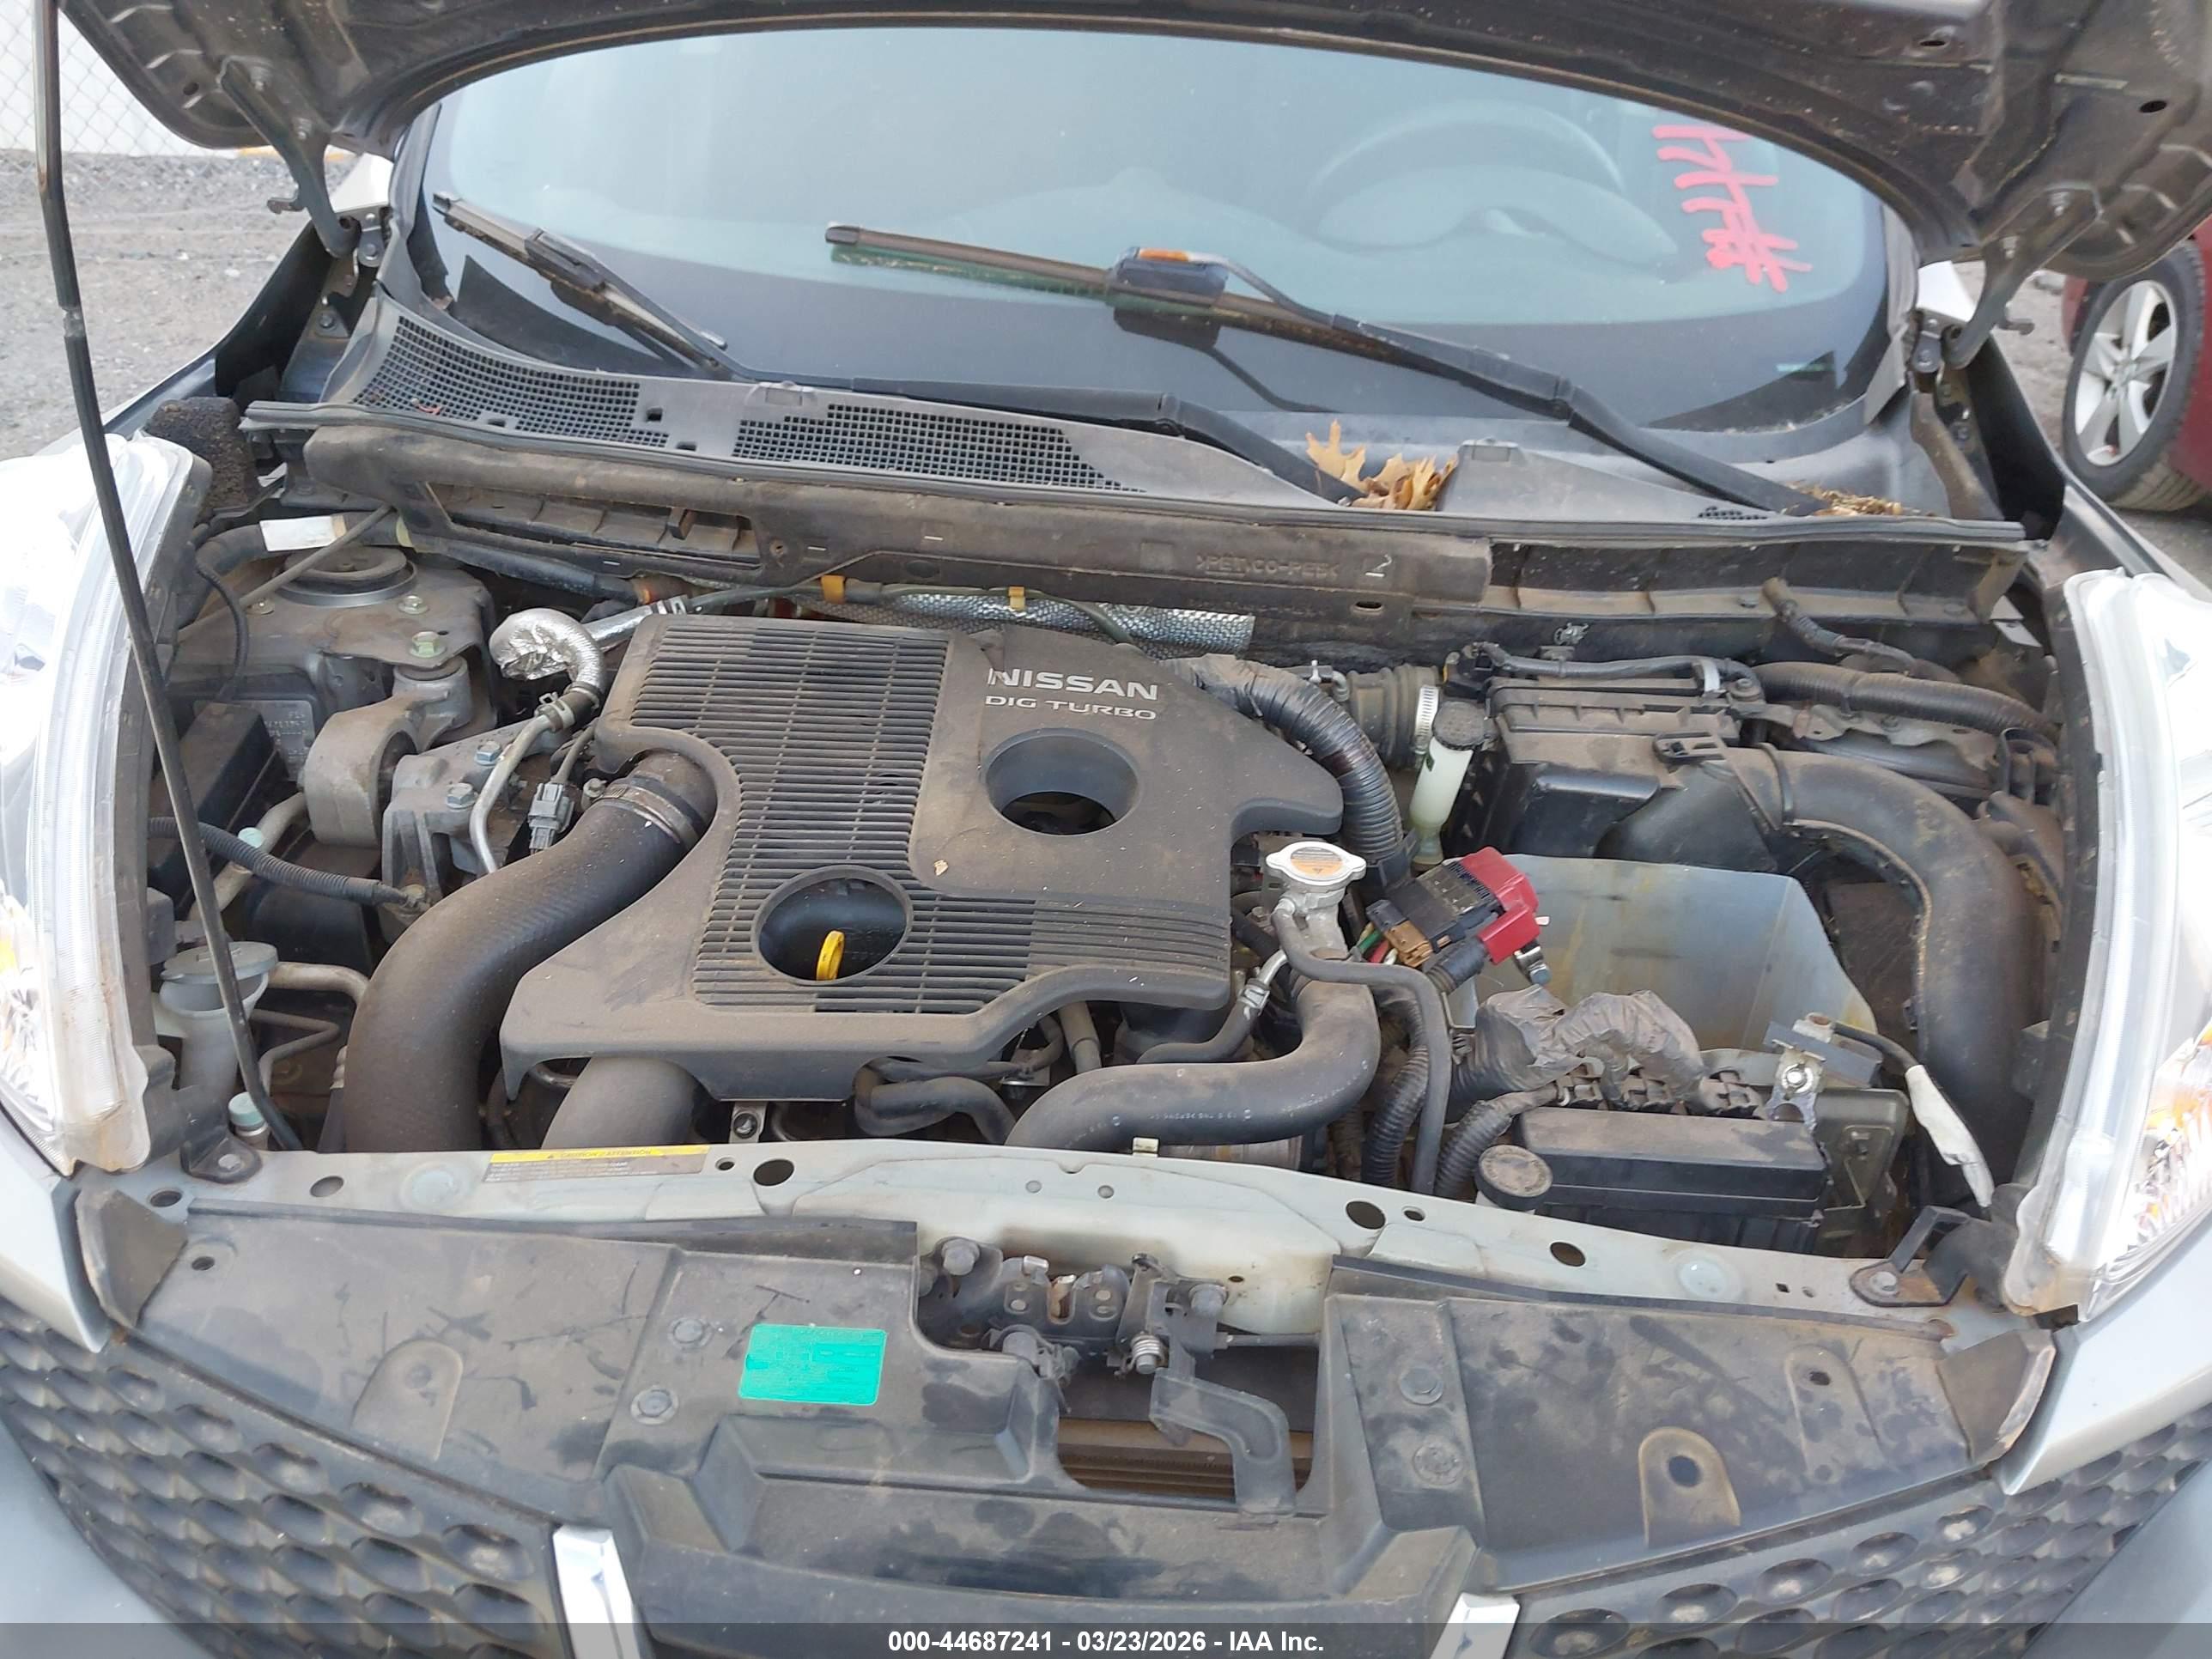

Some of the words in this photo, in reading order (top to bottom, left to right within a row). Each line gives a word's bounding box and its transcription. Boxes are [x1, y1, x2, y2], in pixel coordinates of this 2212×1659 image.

[988, 667, 1158, 701] NISSAN
[985, 696, 1037, 709] DIG
[1044, 700, 1158, 720] TURBO
